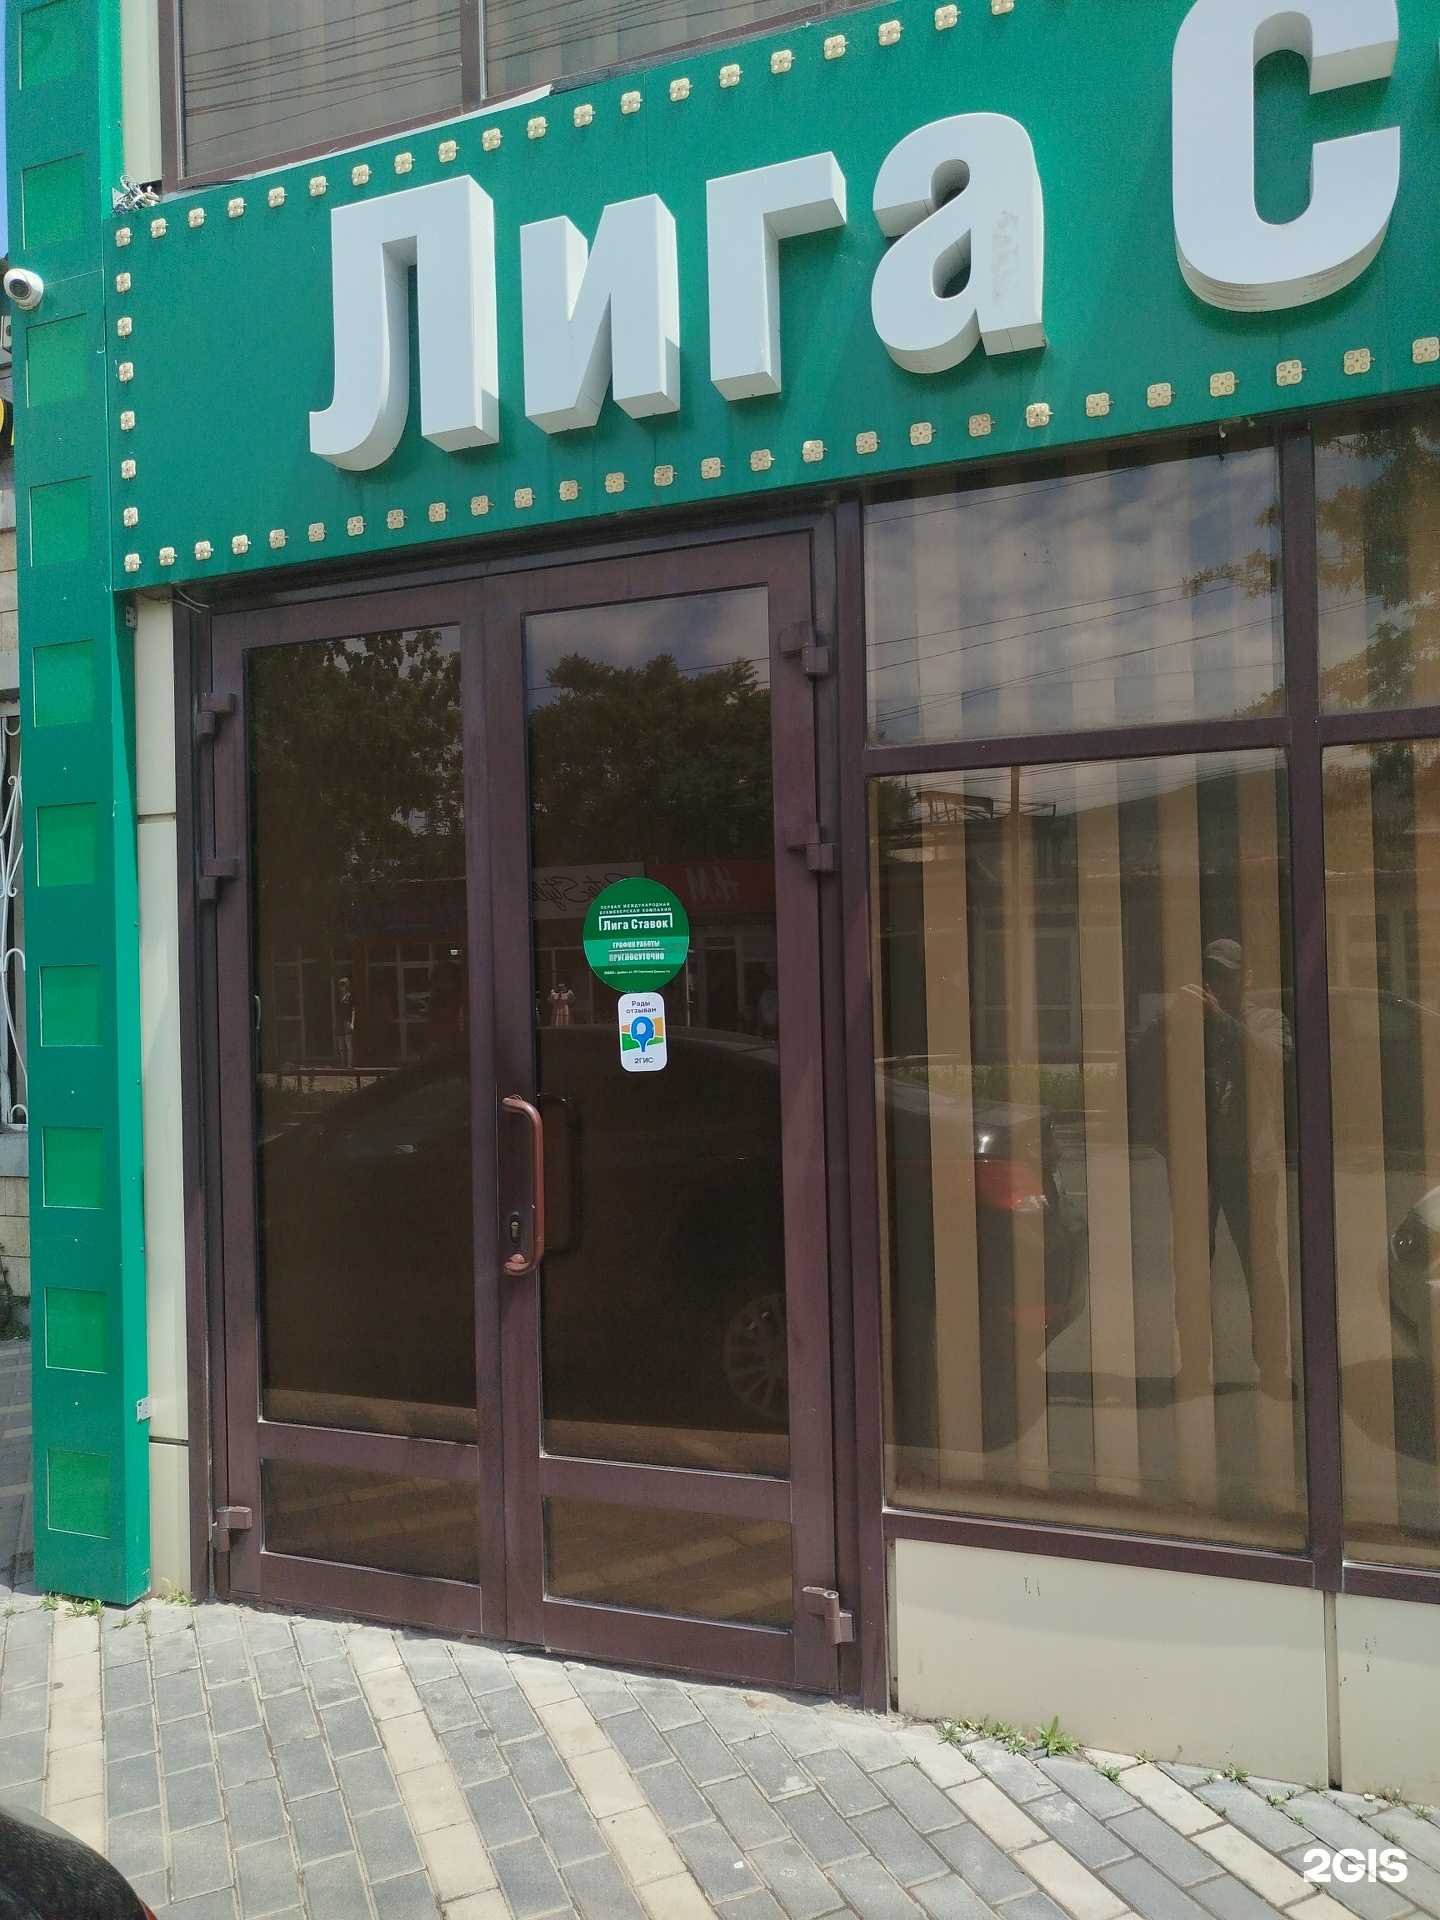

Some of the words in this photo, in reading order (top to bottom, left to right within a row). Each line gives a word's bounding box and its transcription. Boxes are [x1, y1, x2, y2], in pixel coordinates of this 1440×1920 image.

[309, 112, 1047, 473] Лига
[602, 920, 629, 931] Лига
[630, 918, 669, 930] Ставок
